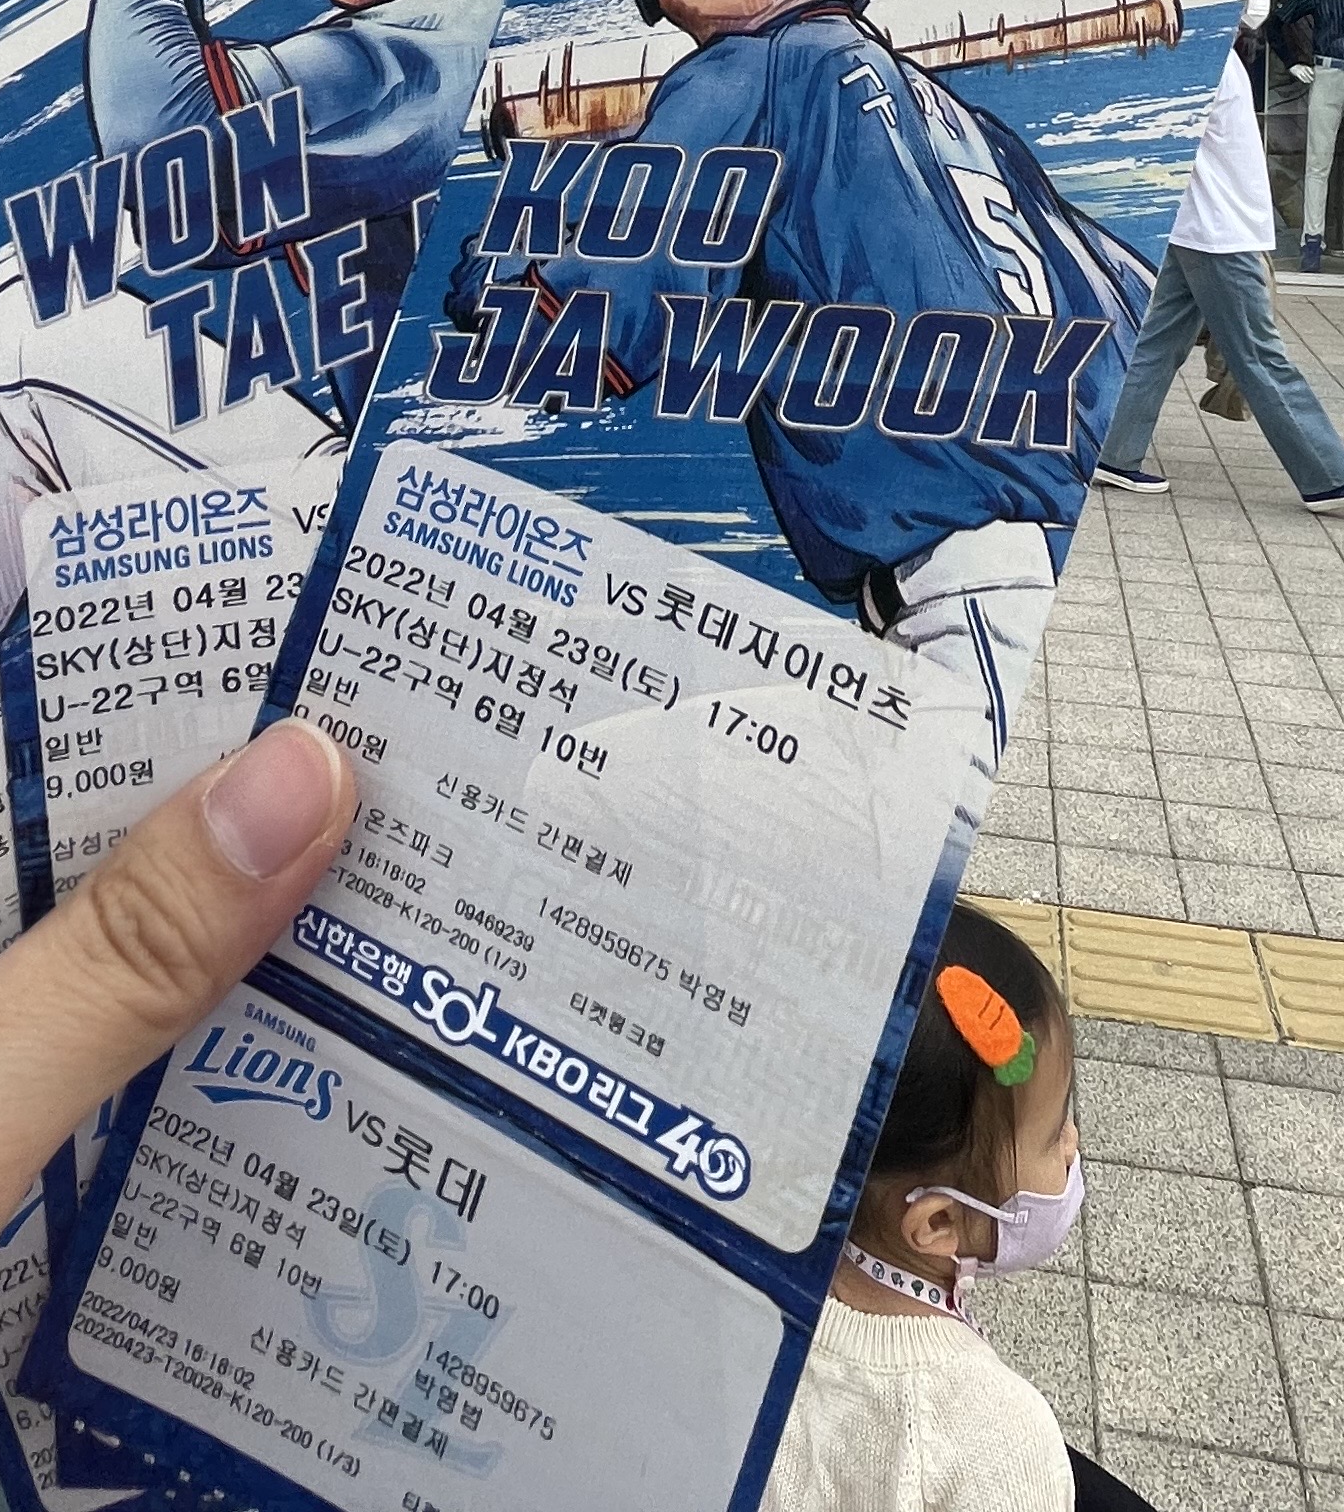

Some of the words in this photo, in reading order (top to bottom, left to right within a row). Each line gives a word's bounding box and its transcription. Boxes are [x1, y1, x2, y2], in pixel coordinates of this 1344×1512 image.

[2, 86, 311, 327] WON
[476, 137, 786, 267] KOO
[142, 220, 375, 434] TAE
[423, 286, 612, 415] JA
[654, 294, 1115, 454] WOOK
[49, 485, 271, 559] 삼성라이온즈
[292, 502, 330, 536] VS
[54, 543, 190, 589] SAMSUNG
[198, 534, 274, 572] LIONS
[382, 509, 504, 578] SAMSUNG
[506, 561, 580, 609] LIONS
[32, 590, 155, 639] 2022년
[172, 575, 249, 612] 04월
[264, 571, 305, 601] 23
[395, 463, 595, 579] 삼성라이온즈
[604, 571, 648, 617] VS
[656, 580, 913, 734] 롯데자이언츠
[35, 615, 290, 681] SKY(상단)지정
[220, 660, 274, 695] 6열
[305, 666, 363, 709] 일반
[330, 591, 580, 714] SKY(상단)지정석
[346, 544, 457, 607] 2022년
[467, 590, 539, 646] 04월
[551, 627, 682, 712] 23일(토)
[706, 698, 802, 767] 17:00
[44, 726, 104, 764] 일반
[46, 756, 155, 801] 9.000원
[473, 694, 527, 739] 6열
[539, 724, 610, 782] 10번
[435, 771, 531, 835] 신용카드
[536, 819, 634, 889] 간편결제
[483, 942, 529, 983] (1/3)
[538, 894, 673, 982] 1428959675
[678, 966, 754, 1029] 박영범
[244, 1001, 317, 1053] SAMSUNG
[294, 908, 413, 1000] 신한은행
[412, 966, 499, 1046] SOL
[501, 1025, 658, 1136] KBO리그
[183, 1026, 344, 1121] Lions
[346, 1099, 386, 1148] VS
[383, 1122, 490, 1225] 롯데
[111, 1211, 158, 1252] 일반
[135, 1144, 307, 1250] SKY(상단)지정석
[148, 1105, 235, 1167] 2022년
[243, 1151, 299, 1202] 04월
[306, 1187, 412, 1266] 23일(토)
[430, 1258, 500, 1320] 17:00
[96, 1246, 181, 1303] 9.000원
[228, 1232, 267, 1269] 6열
[276, 1257, 323, 1300] 10번
[81, 1290, 178, 1348] 2022/04/23
[250, 1325, 345, 1396] 신용카드
[353, 1381, 449, 1460] 간편결제
[424, 1340, 557, 1441] 1428959675
[316, 1437, 361, 1478] (1/3)
